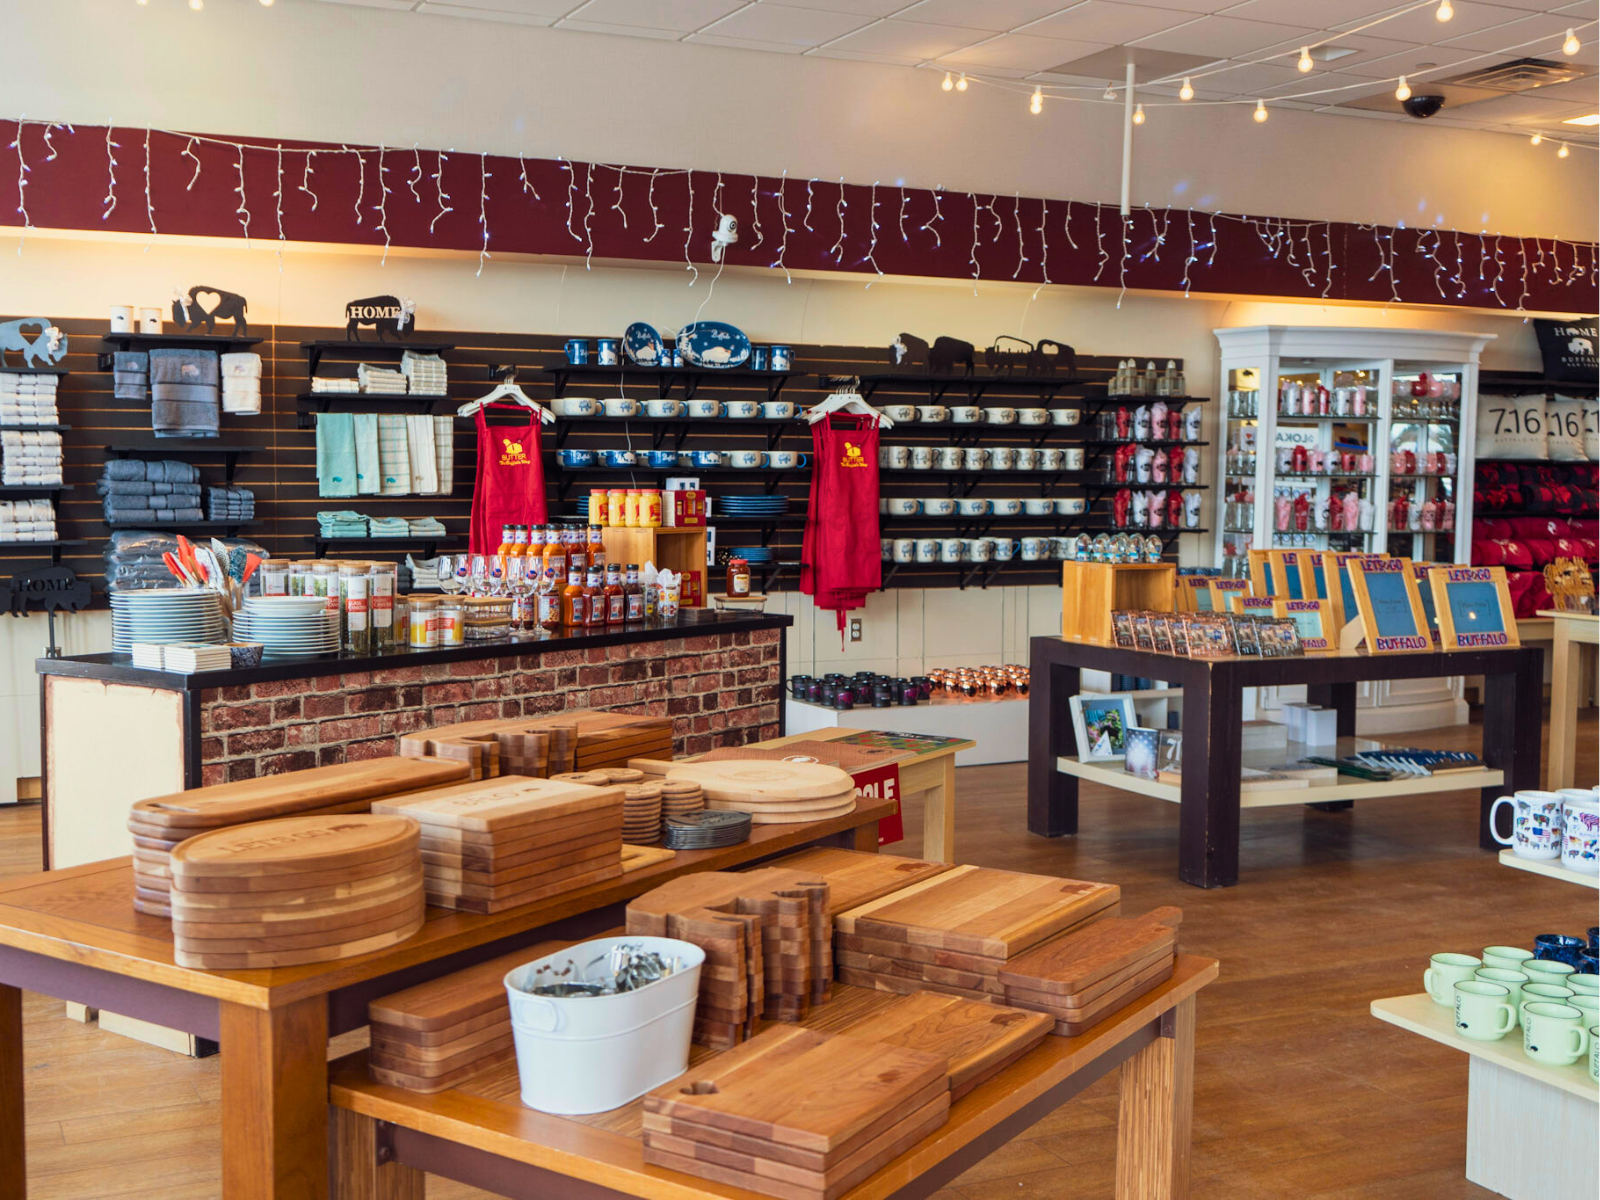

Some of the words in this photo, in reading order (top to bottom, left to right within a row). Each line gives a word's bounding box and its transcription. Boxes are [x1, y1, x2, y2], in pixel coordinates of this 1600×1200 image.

[350, 306, 400, 319] HOME
[1488, 408, 1541, 434] 716
[1545, 412, 1579, 437] 16
[18, 578, 75, 592] HOME
[1376, 635, 1427, 650] BUFFALO
[1457, 633, 1508, 647] BUFFALO
